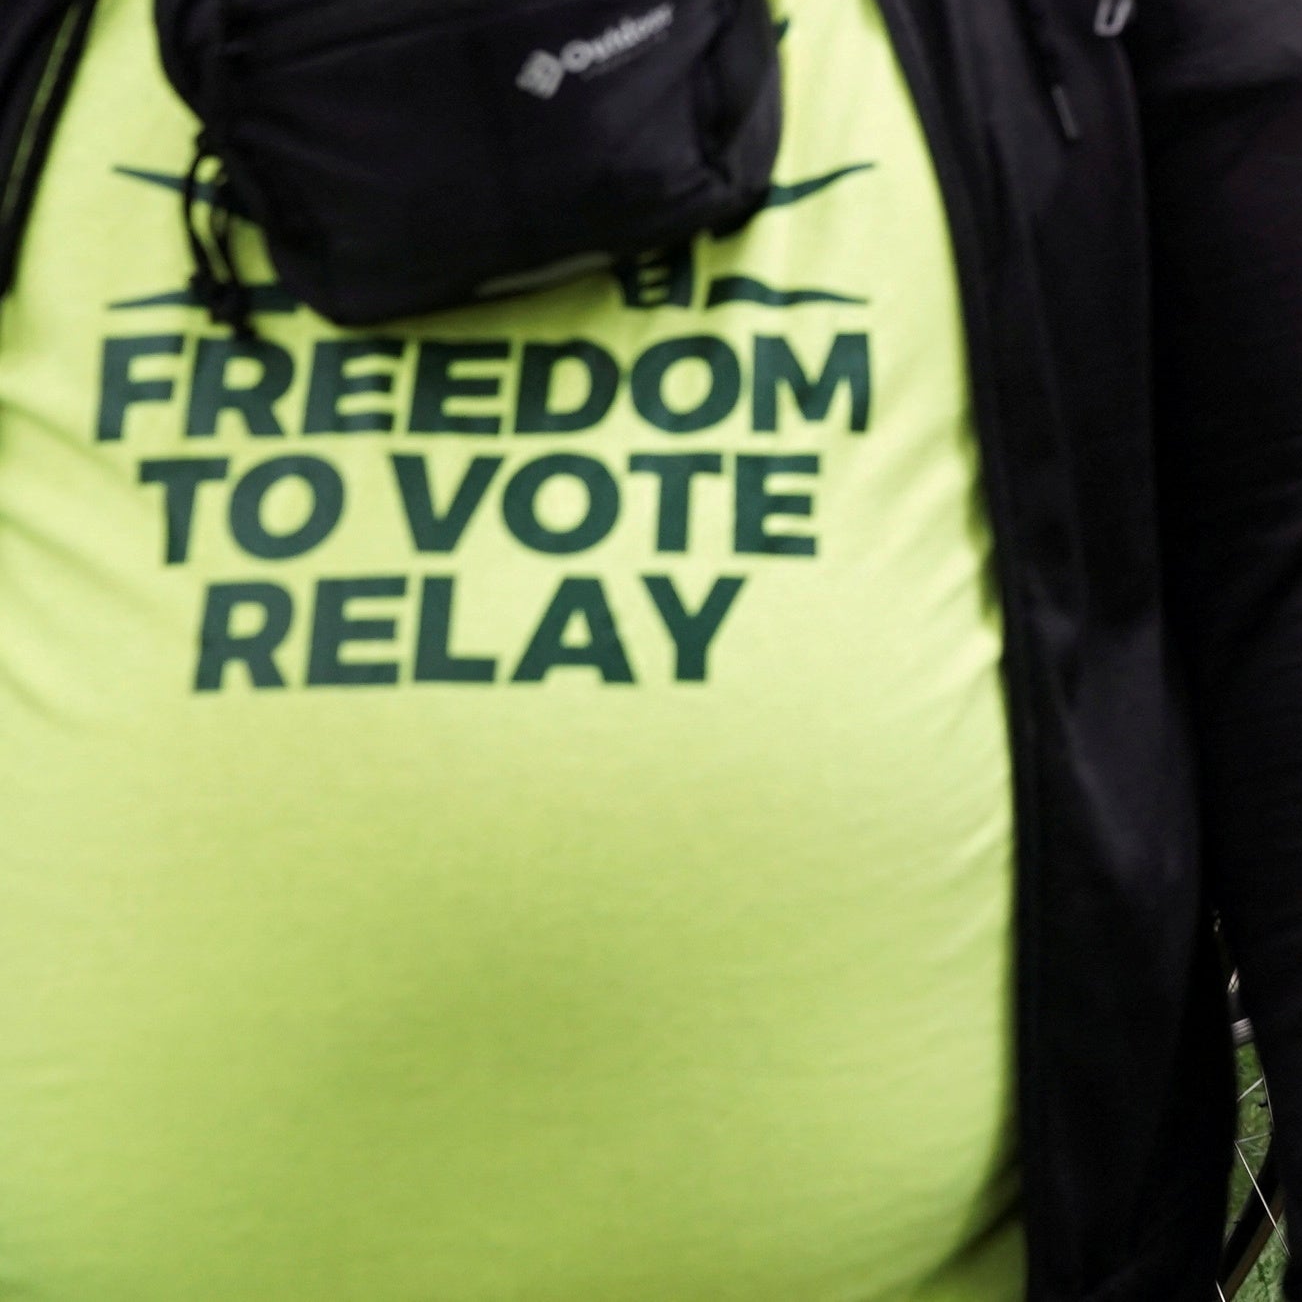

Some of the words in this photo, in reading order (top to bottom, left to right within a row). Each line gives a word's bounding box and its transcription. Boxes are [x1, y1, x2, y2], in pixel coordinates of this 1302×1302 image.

[94, 332, 873, 443] FREEDOM
[135, 453, 346, 566] TO
[390, 453, 822, 558] VOTE
[193, 574, 748, 695] RELAY
